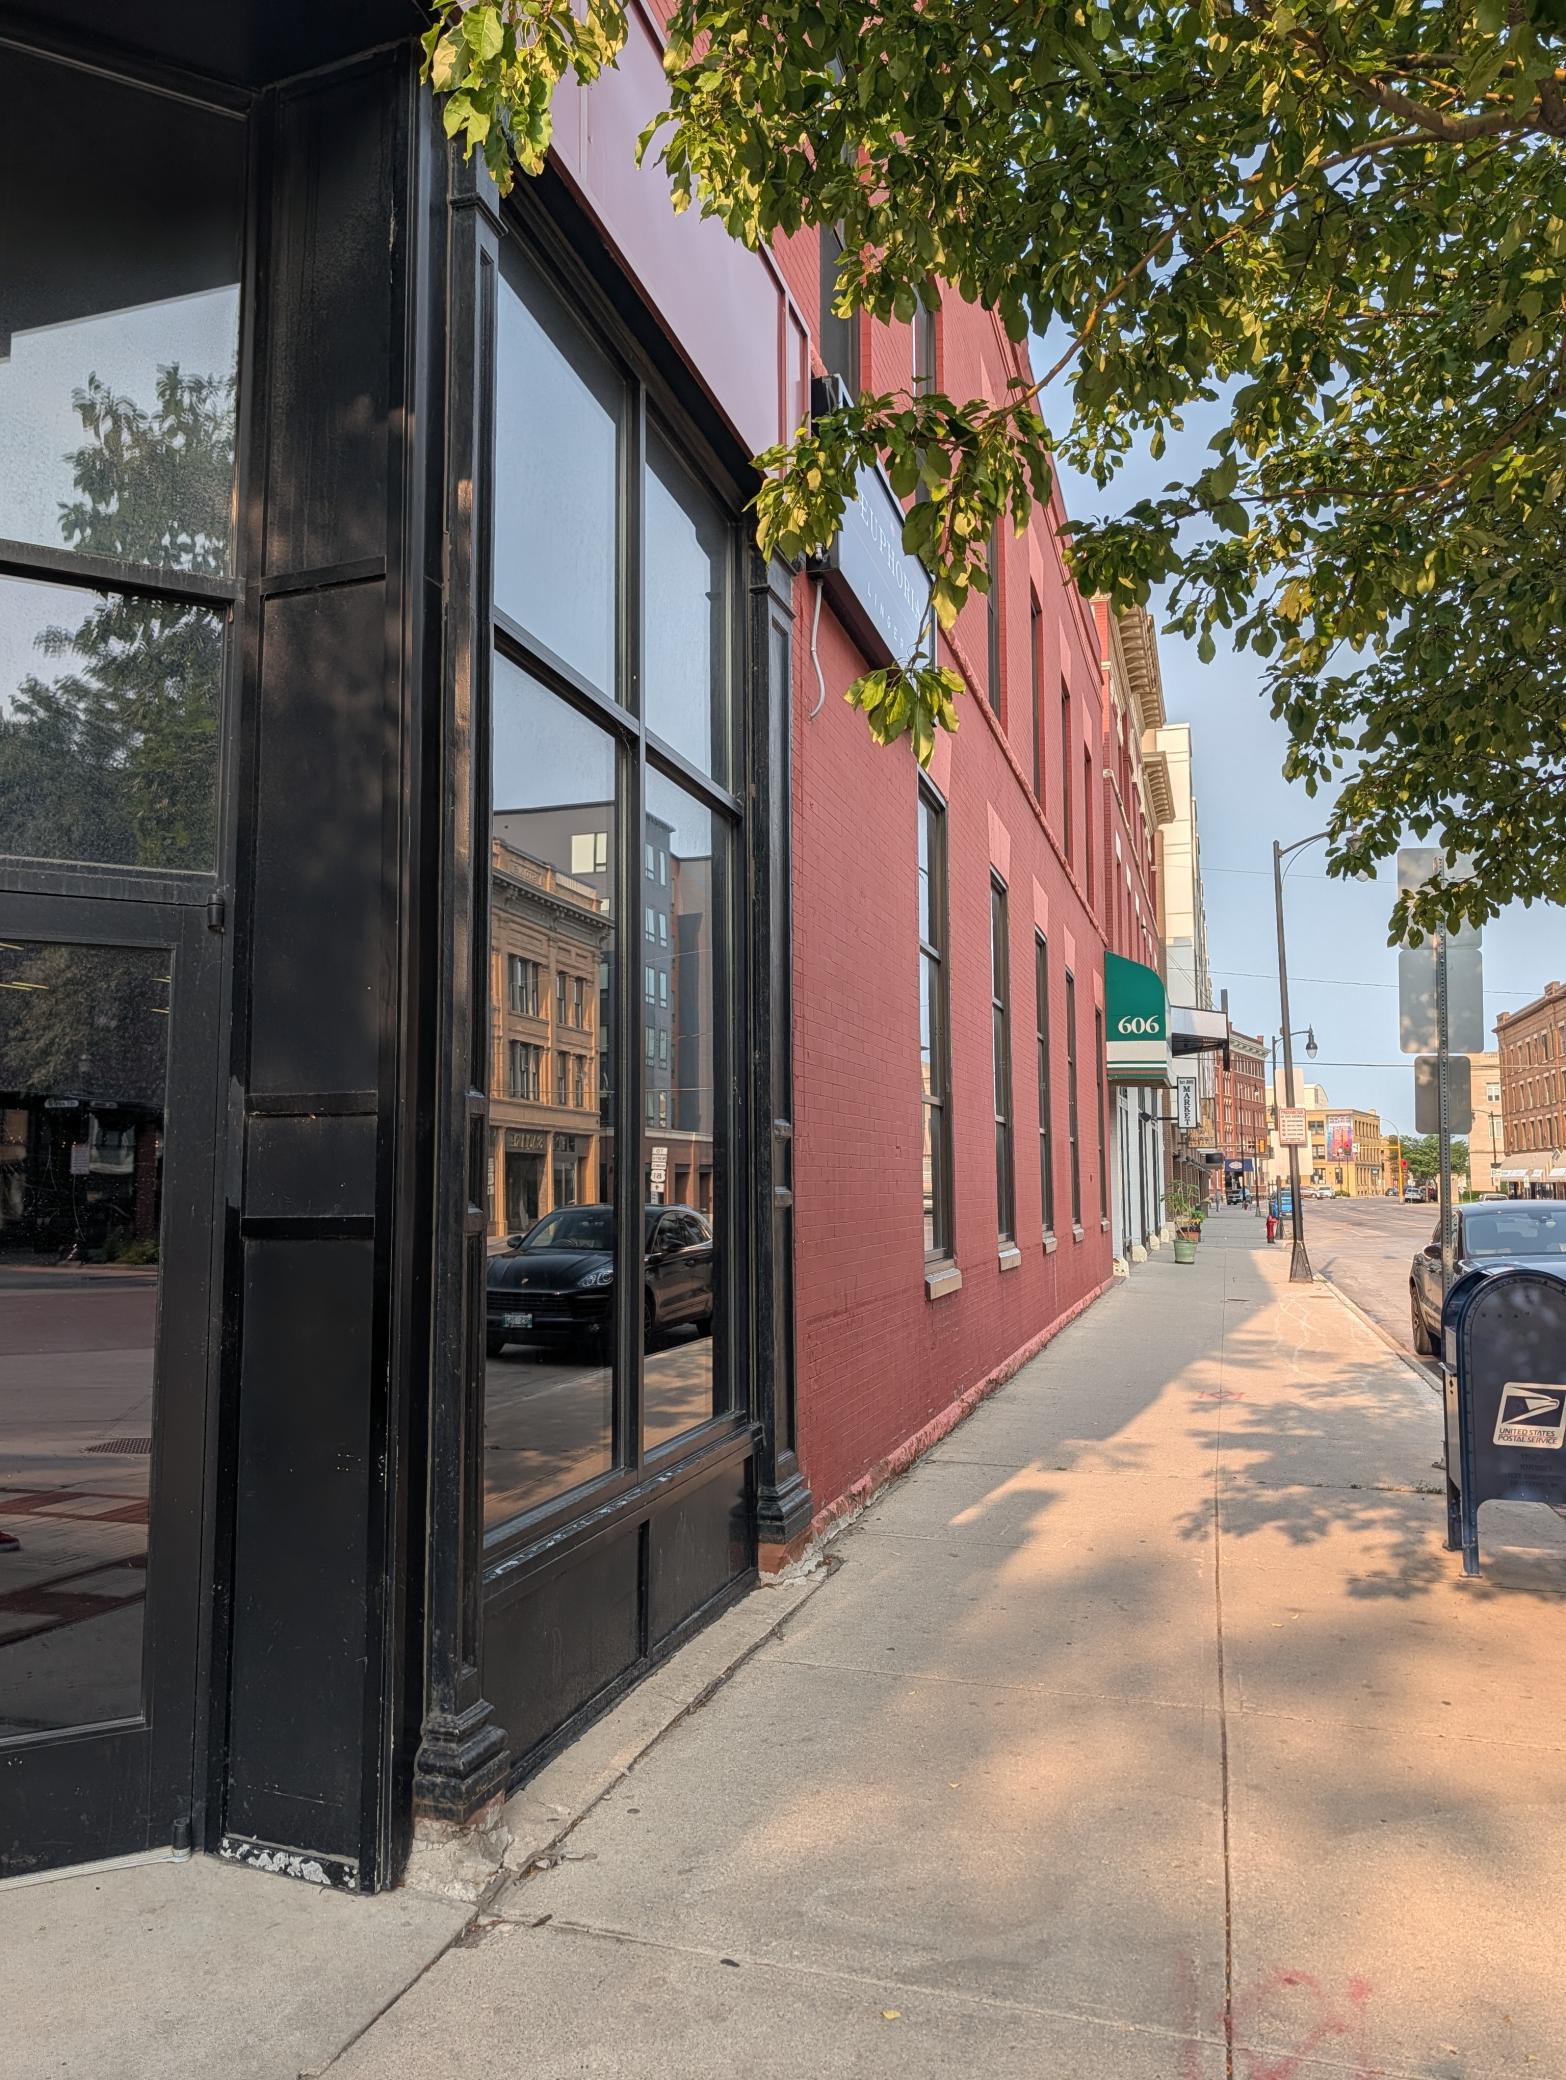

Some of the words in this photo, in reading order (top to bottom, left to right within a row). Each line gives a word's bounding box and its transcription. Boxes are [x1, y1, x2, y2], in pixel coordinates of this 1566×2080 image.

[860, 490, 921, 619] EUPHORIA
[867, 581, 908, 655] LINGER
[1118, 1015, 1159, 1034] 606
[1183, 1086, 1191, 1126] MARKET
[1498, 1434, 1525, 1442] POSTAL
[1527, 1436, 1557, 1444] SERVICE
